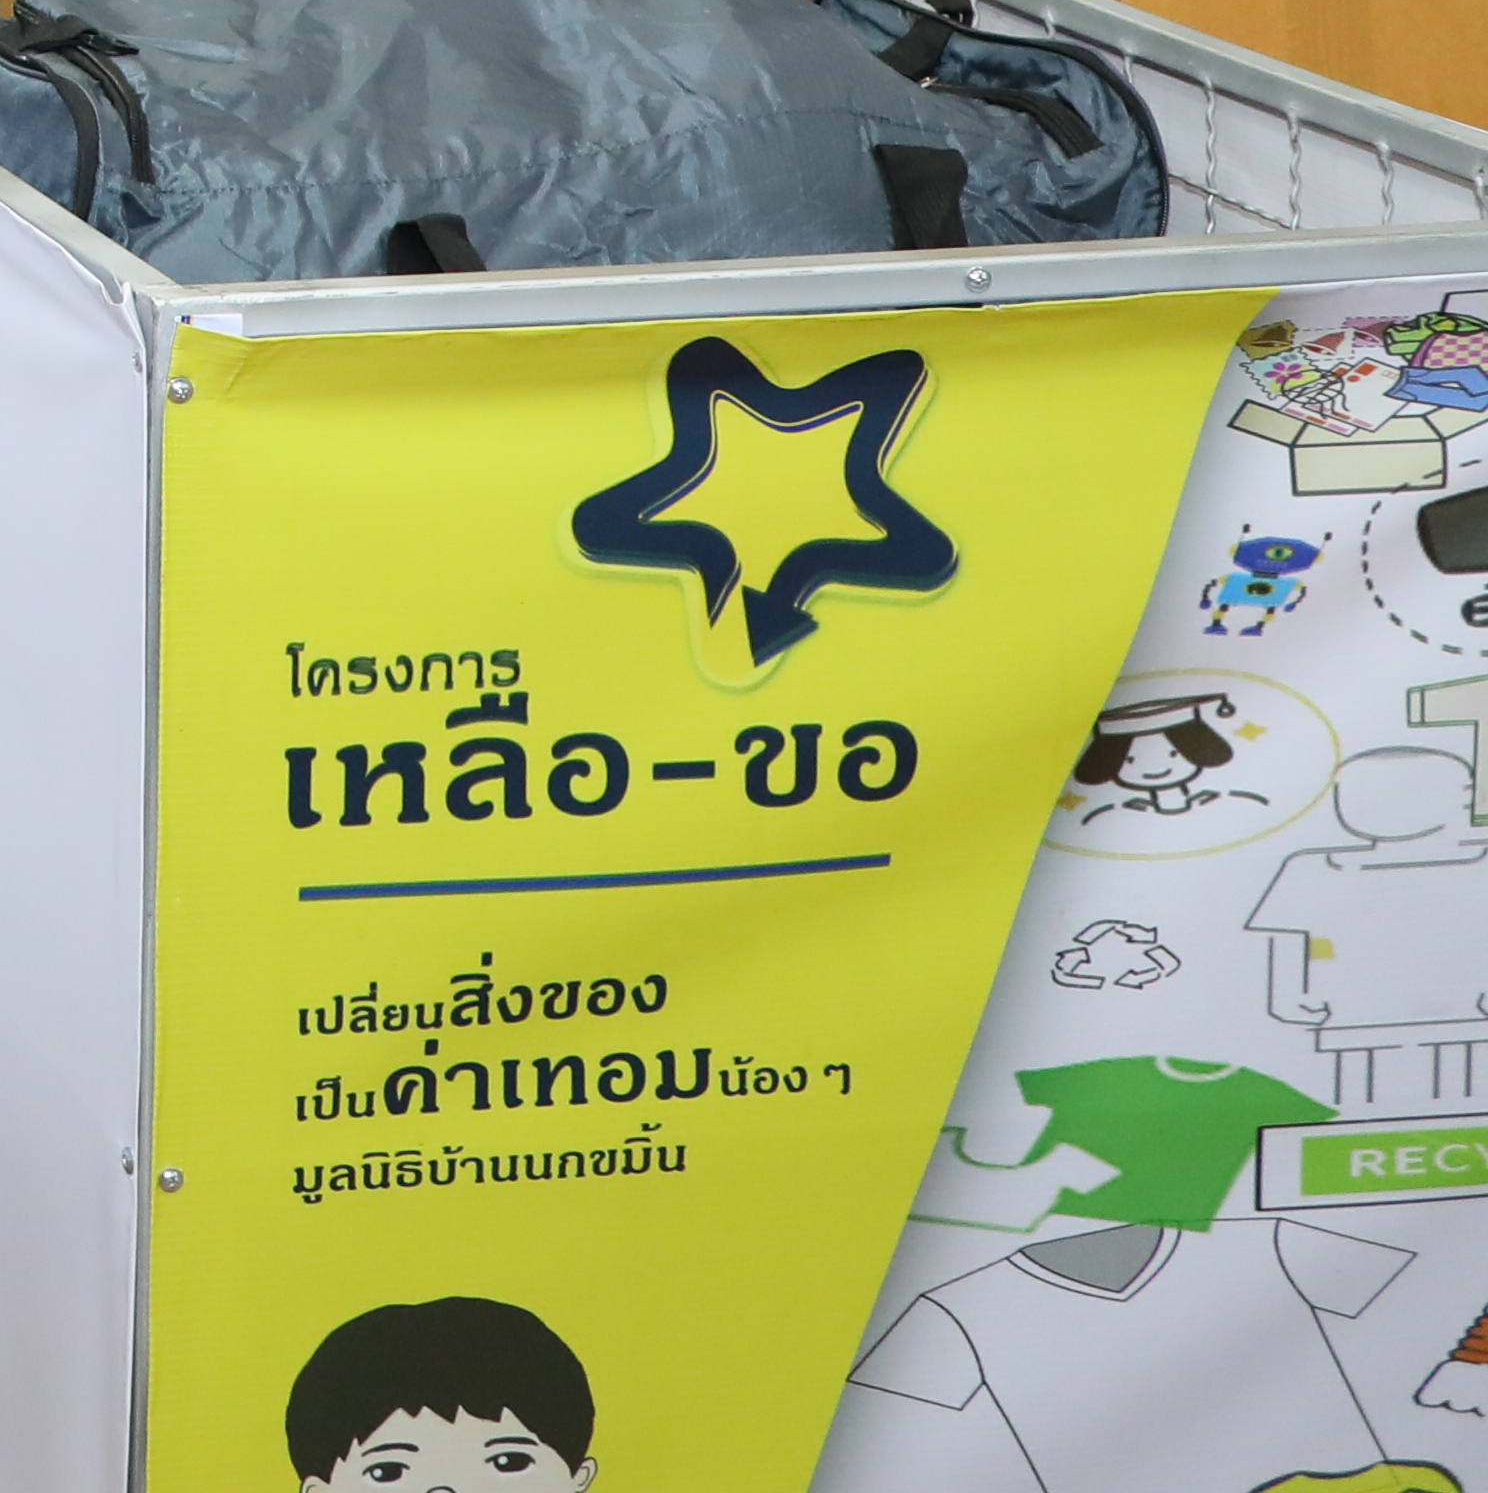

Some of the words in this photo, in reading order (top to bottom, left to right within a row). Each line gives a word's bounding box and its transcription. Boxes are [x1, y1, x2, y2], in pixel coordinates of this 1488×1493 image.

[285, 642, 523, 698] โครงการ
[298, 952, 668, 1038] เปลี่ยนสิ่งของ
[293, 1122, 687, 1205] มูลนิธิบ้านนกขมิ้น
